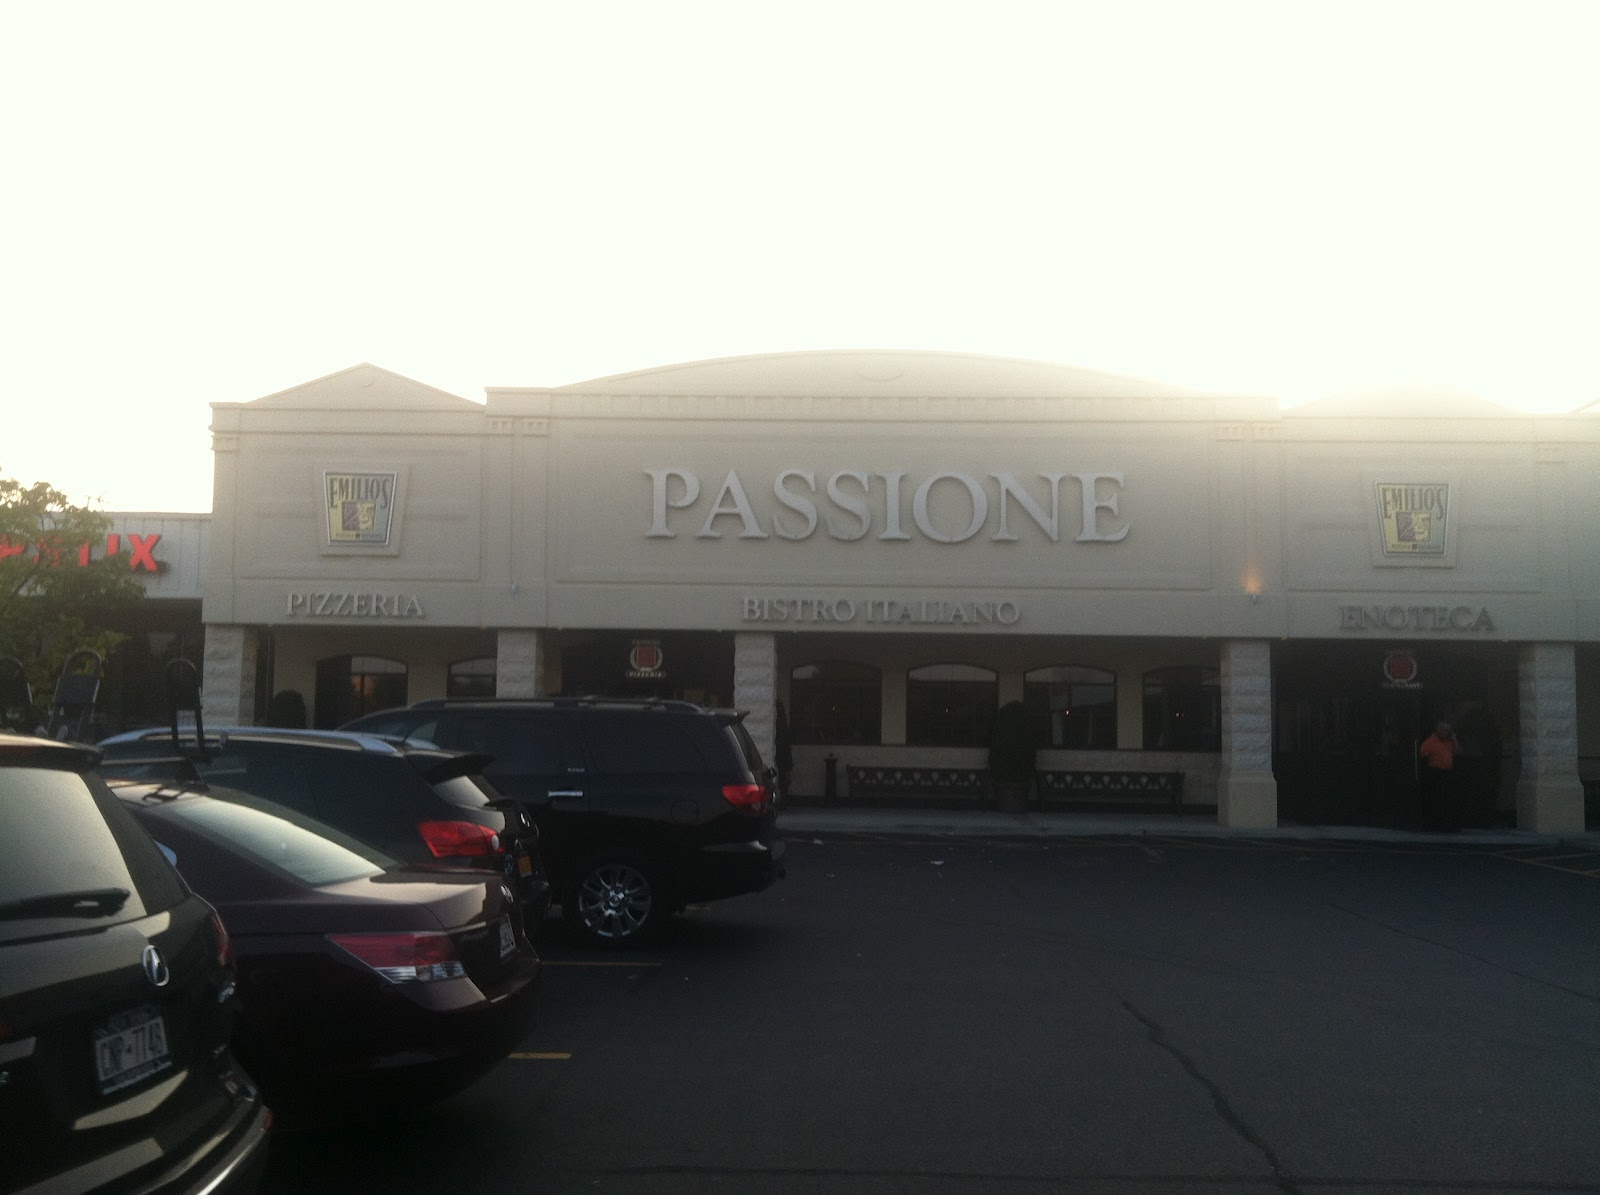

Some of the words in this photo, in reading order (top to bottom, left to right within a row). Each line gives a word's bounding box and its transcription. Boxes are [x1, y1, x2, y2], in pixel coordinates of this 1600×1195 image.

[644, 468, 1130, 545] PASSIONE
[286, 592, 426, 619] PIZZERIA
[742, 597, 857, 624] BISTRO
[864, 599, 1022, 626] ITALIANO
[1340, 604, 1497, 632] ENOTECA
